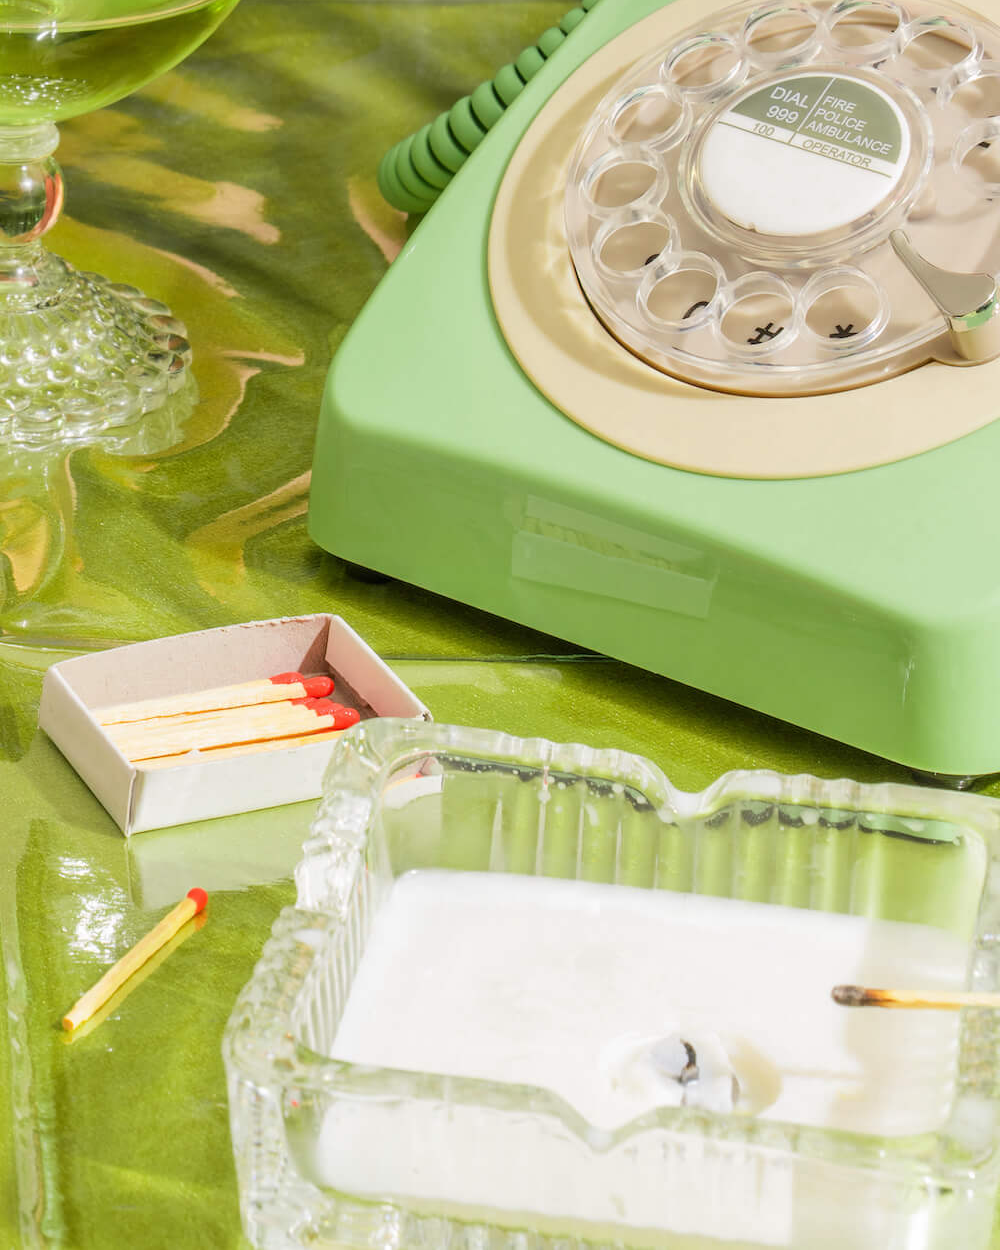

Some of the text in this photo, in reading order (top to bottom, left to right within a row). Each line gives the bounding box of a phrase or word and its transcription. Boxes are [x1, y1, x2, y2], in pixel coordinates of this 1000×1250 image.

[770, 86, 809, 109] DIAL
[822, 95, 857, 113] FIRE
[766, 105, 799, 124] 999
[814, 108, 868, 132] POLICE
[752, 122, 872, 168] 100 OPERATOR
[805, 120, 893, 155] AMBULANCE
